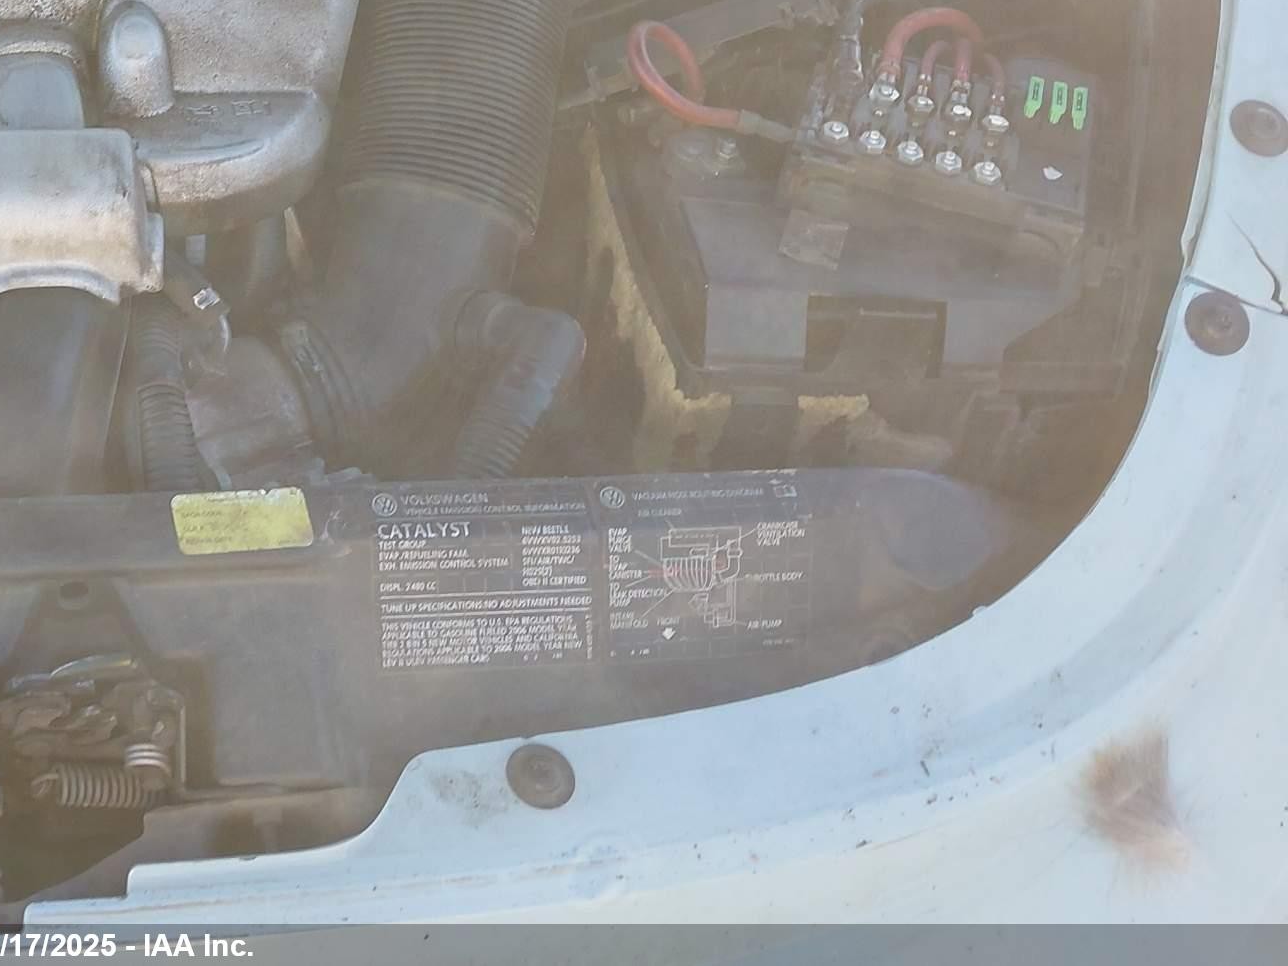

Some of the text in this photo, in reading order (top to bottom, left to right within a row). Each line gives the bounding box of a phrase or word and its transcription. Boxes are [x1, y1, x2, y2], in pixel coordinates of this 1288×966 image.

[400, 493, 489, 506] VOLKSWAGEN
[484, 504, 522, 514] CONTROL
[377, 521, 471, 539] CATALYST
[521, 524, 569, 536] NEW BEETLE
[757, 529, 806, 538] VENTILATION
[378, 539, 427, 551] TEST GROUP
[399, 560, 438, 571] EMISSION
[440, 559, 477, 570] CONTROL
[478, 557, 510, 568] SYSTEM
[426, 581, 437, 591] CC
[549, 575, 587, 586] CERTIFIED
[380, 603, 403, 614] TUNE
[404, 602, 418, 613] UP
[499, 597, 559, 610] ADJUSTMENTS
[560, 595, 592, 607] NEEDED
[400, 620, 431, 631] VEHICLE
[431, 619, 475, 629] CONFORMS
[476, 618, 488, 627] TO
[521, 614, 573, 625] REGULATIONS
[762, 619, 783, 629] PUMP
[426, 630, 438, 639] TO
[528, 624, 555, 635] MODEL
[515, 633, 533, 643] AND
